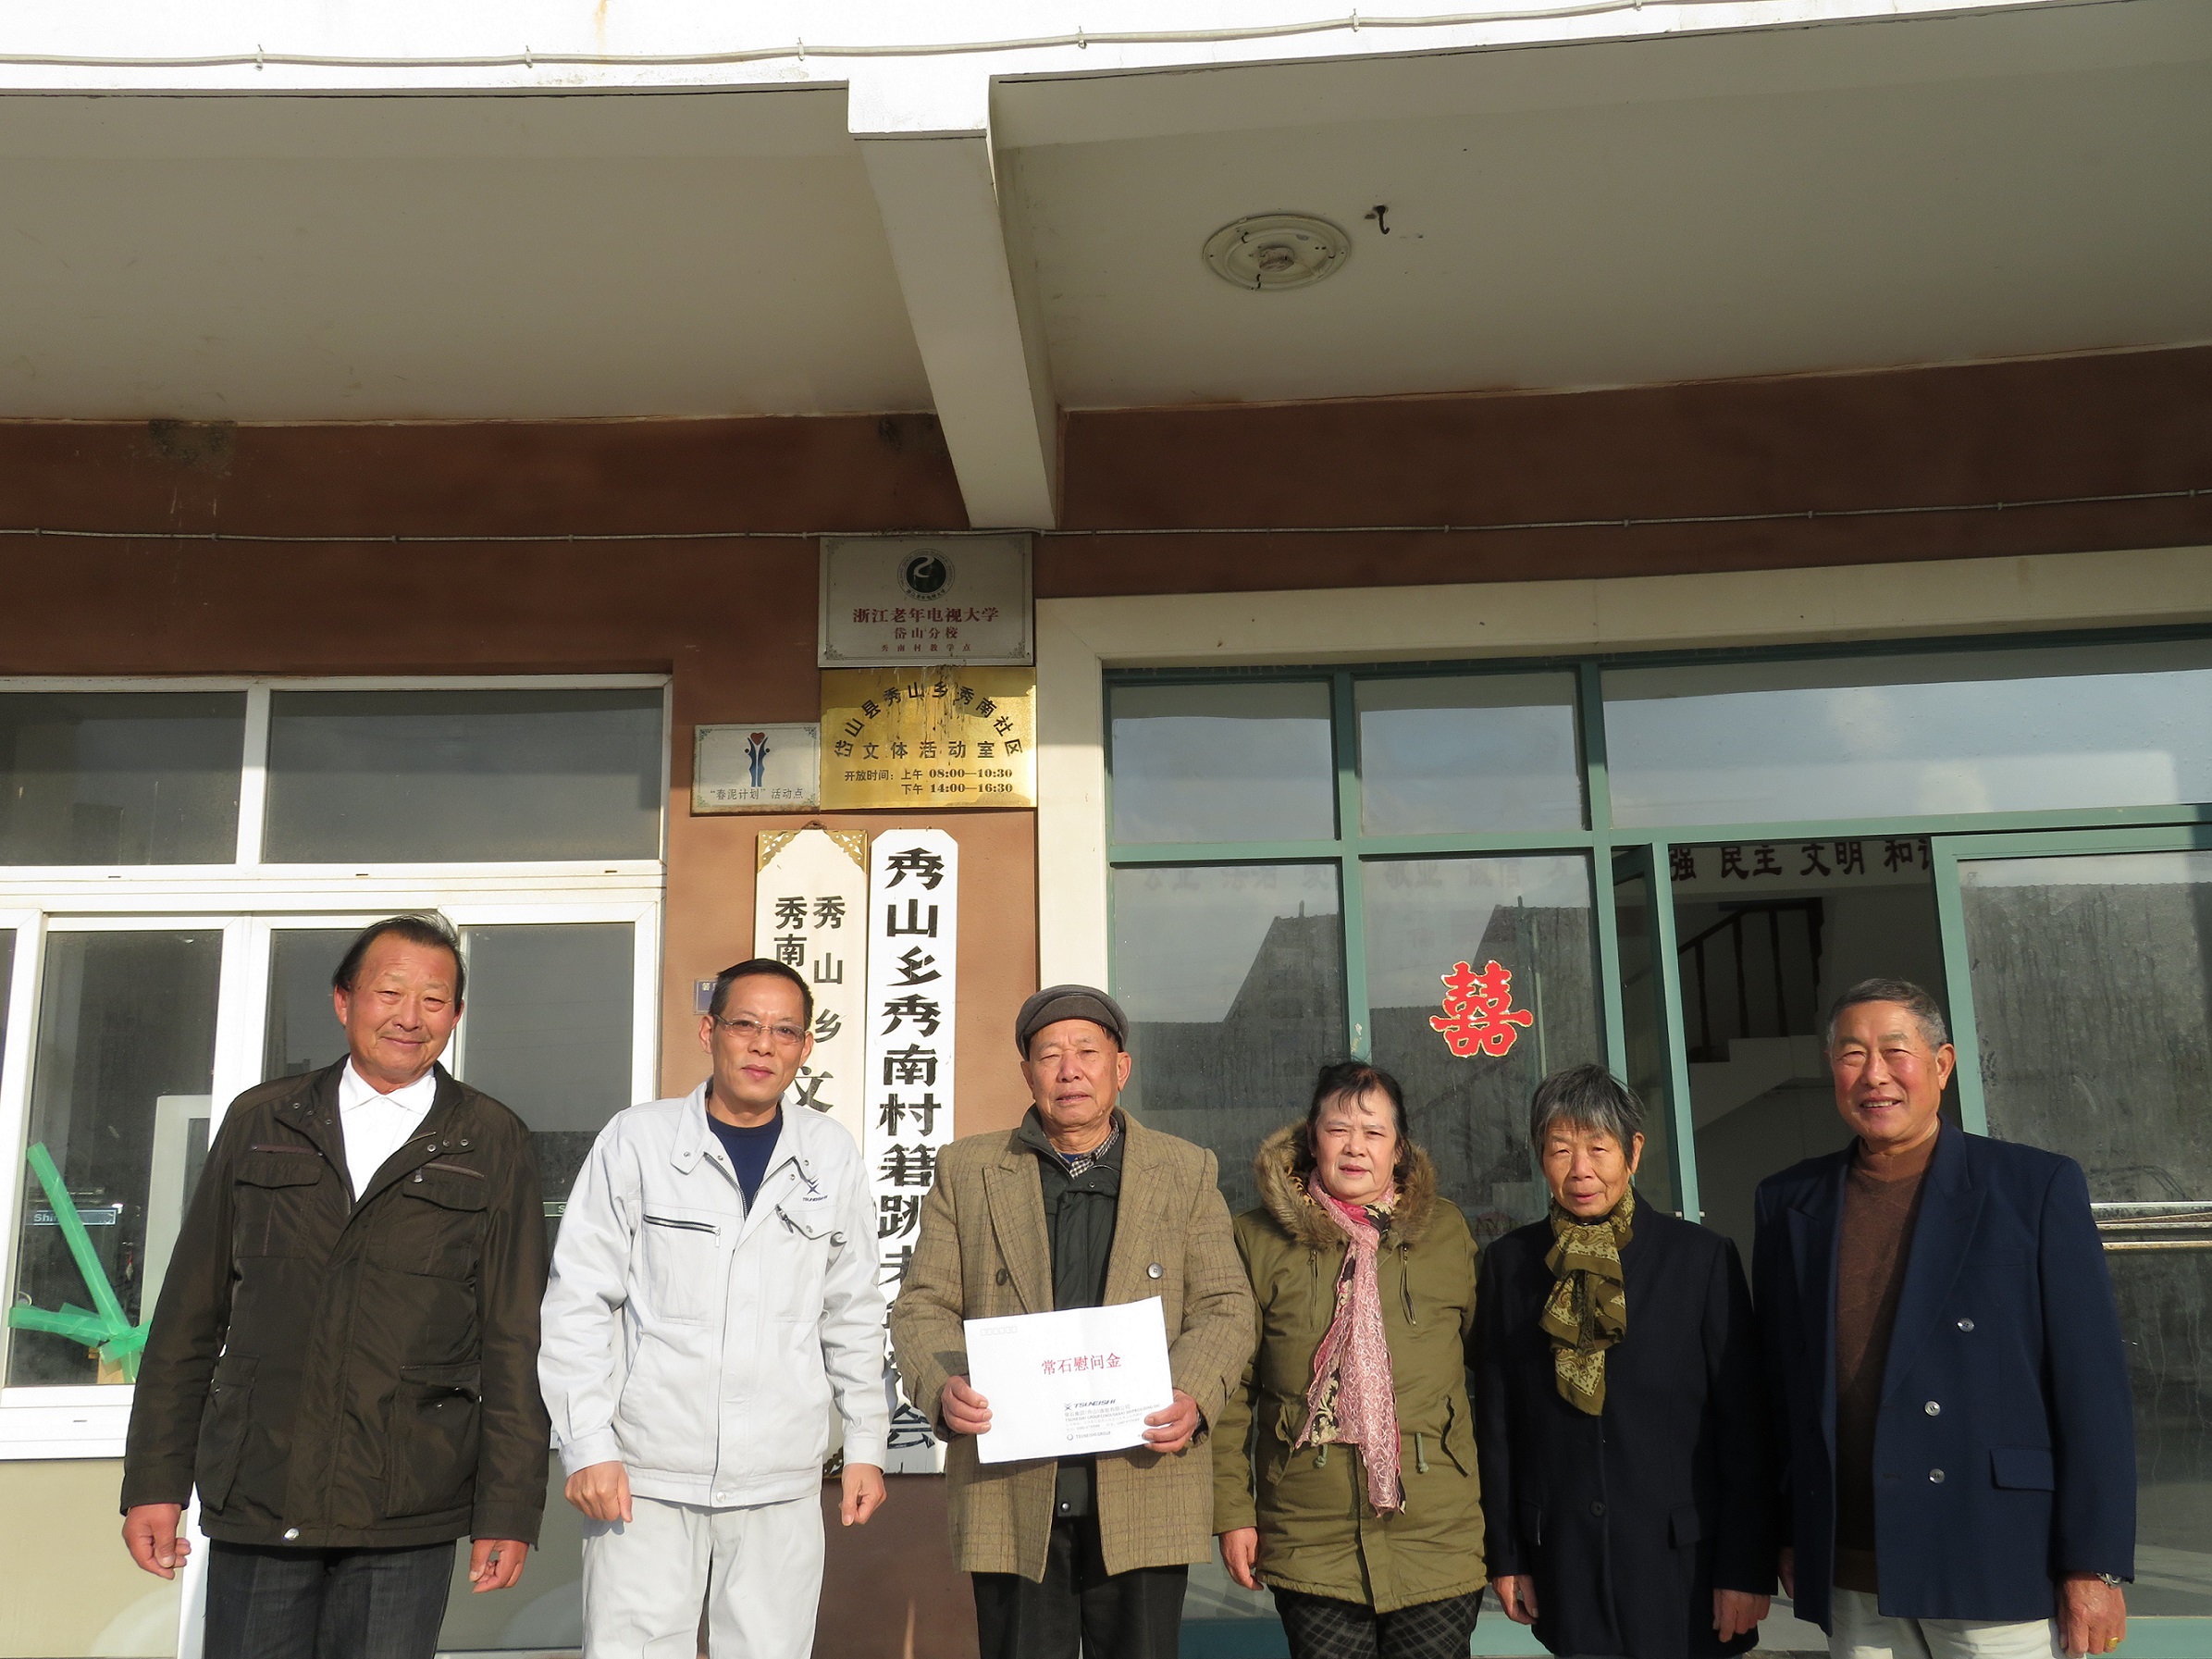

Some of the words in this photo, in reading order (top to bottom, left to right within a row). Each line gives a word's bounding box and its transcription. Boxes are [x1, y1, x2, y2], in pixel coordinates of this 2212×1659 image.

[853, 607, 999, 624] 浙江老年电视大学
[895, 626, 958, 639] 岱山分校
[834, 681, 1024, 758] 岱山县秀山乡秀南社区
[862, 740, 995, 760] 文体活动室
[901, 783, 923, 795] 下午
[1721, 845, 1783, 880] 民主
[1800, 841, 1865, 877] 文明
[812, 895, 846, 1044] 秀山乡
[1041, 1352, 1122, 1376] 常石慰问金
